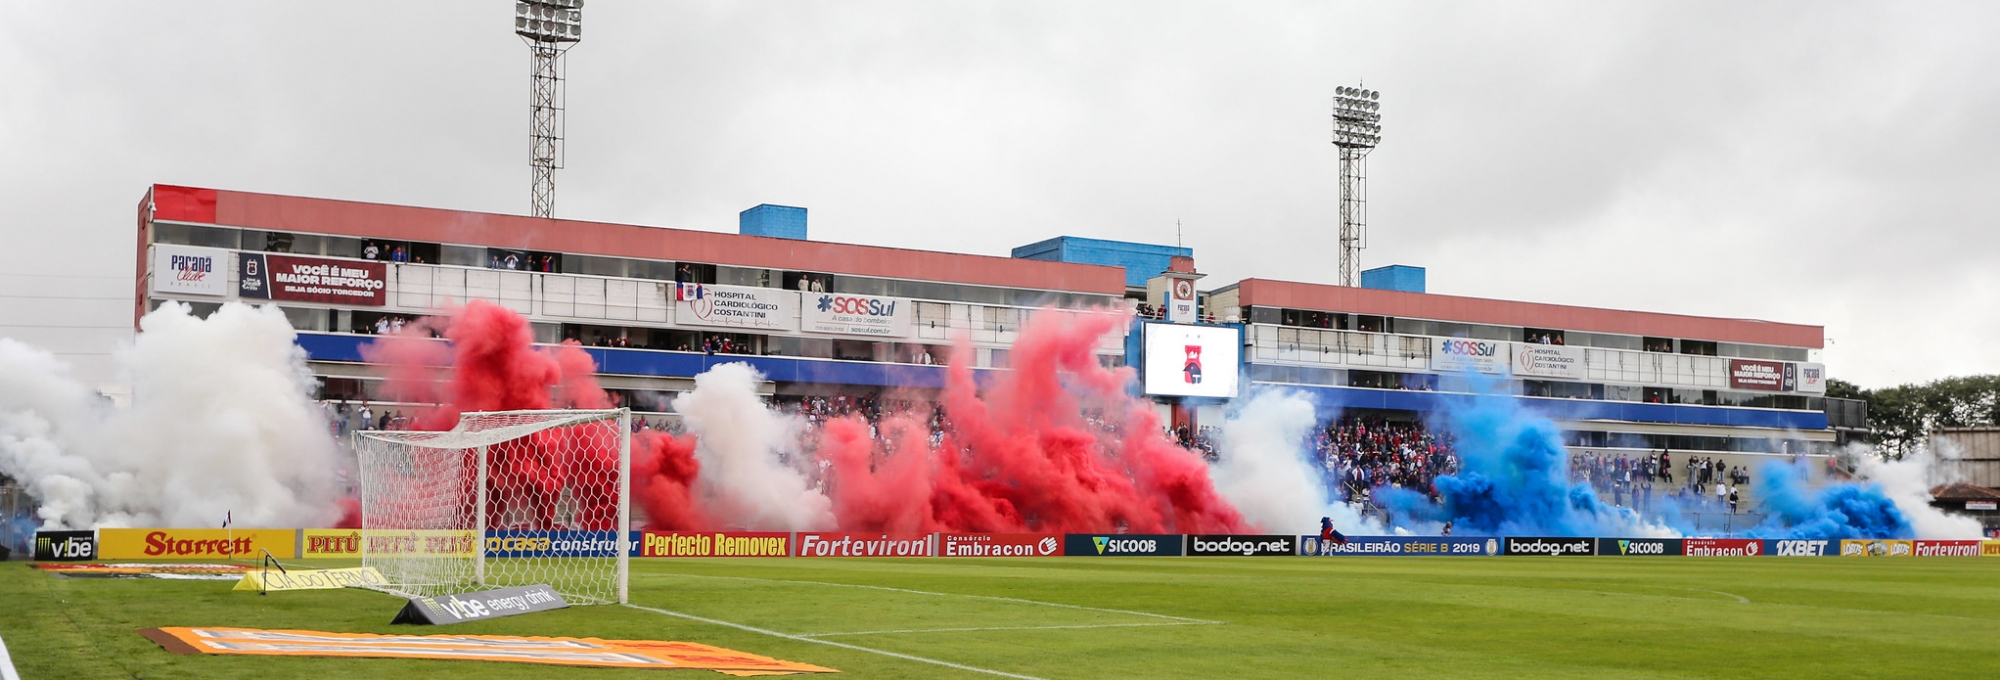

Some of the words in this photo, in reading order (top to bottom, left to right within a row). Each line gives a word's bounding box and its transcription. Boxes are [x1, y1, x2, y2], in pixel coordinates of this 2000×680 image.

[292, 264, 329, 276] VOCÊ
[331, 266, 339, 276] É
[341, 268, 369, 279] MEU
[276, 273, 319, 285] MAIOR
[321, 276, 383, 291] REFORÇO
[285, 285, 305, 293] SEJA
[306, 286, 331, 295] SÓCIO
[332, 288, 374, 297] TORCEDOR
[714, 291, 756, 301] HOSPITAL
[714, 299, 778, 310] CARDIOLÓGICO
[833, 296, 895, 317] SOSSul
[713, 308, 766, 319] COSTANTINI
[1453, 340, 1496, 357] SOSSul
[1535, 355, 1574, 363] CARDIOLÓGICO
[144, 531, 252, 556] Starrett
[307, 531, 361, 554] PITÚ
[552, 538, 639, 551] construtr
[644, 533, 710, 556] Perfecto
[714, 533, 786, 556] Removex
[801, 535, 926, 556] Forteviron
[946, 541, 1033, 556] Embracon
[1108, 539, 1157, 553] SICOOB
[1194, 537, 1290, 555] bodog.net
[1403, 539, 1438, 553] SÉRIE
[1441, 543, 1448, 553] B
[1453, 543, 1480, 553] 2019
[1510, 539, 1589, 556] bodog.net
[1629, 542, 1663, 554] SICOOB
[1776, 540, 1828, 556] 1XBET
[1915, 541, 1978, 556] Forteviron
[1687, 545, 1743, 556] Embracon
[487, 595, 530, 611] energy
[525, 588, 556, 605] drink
